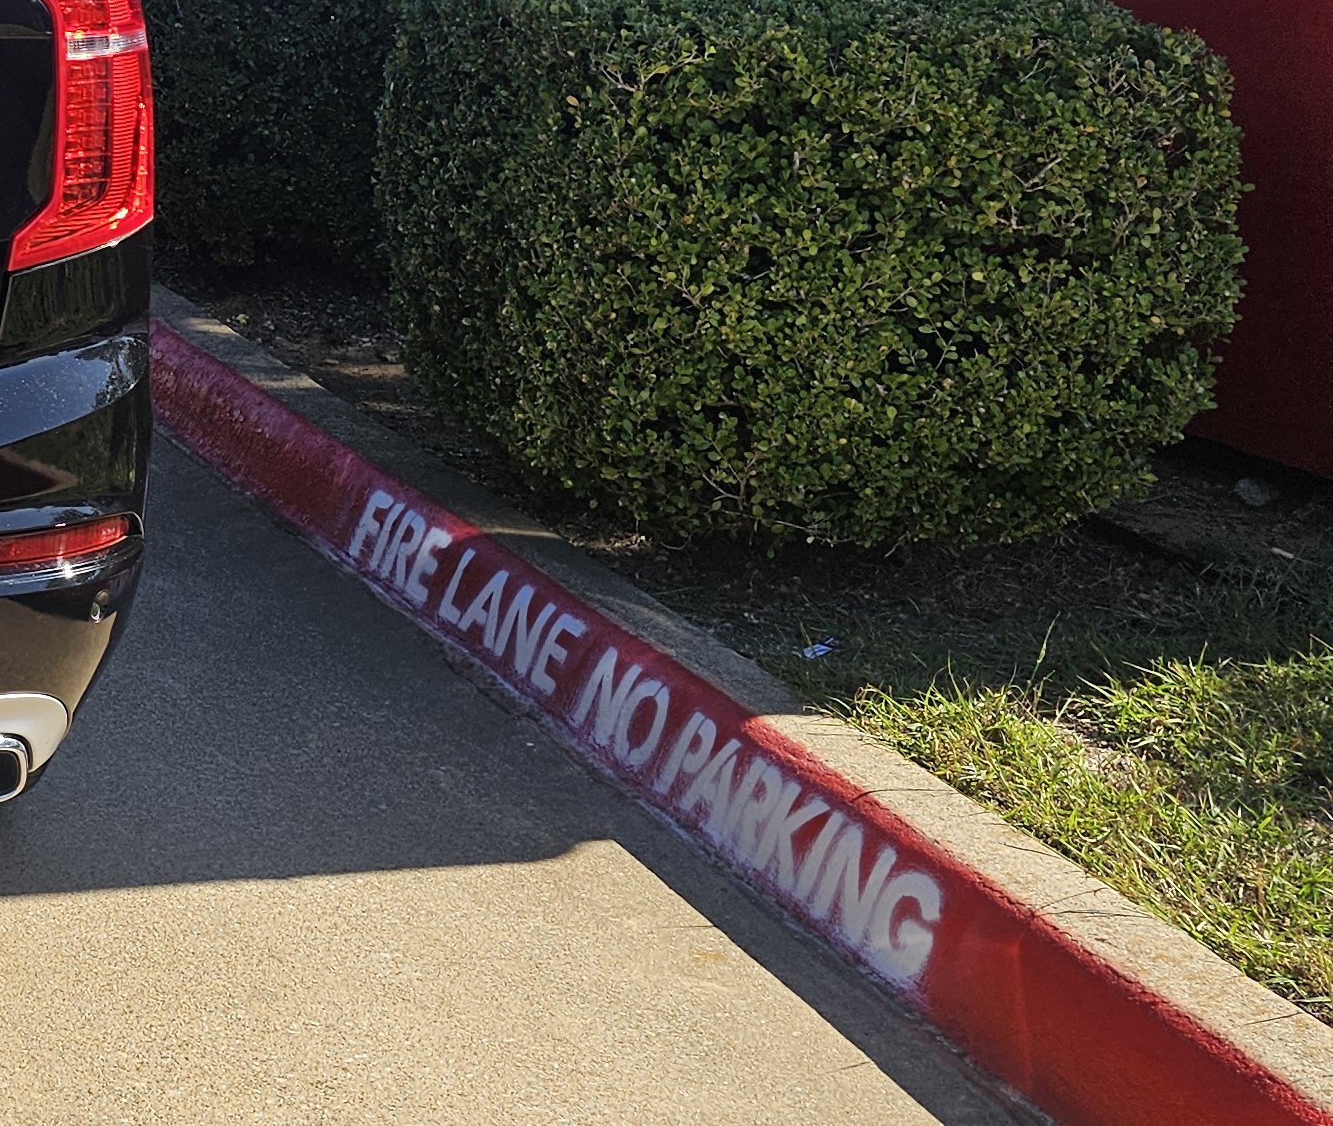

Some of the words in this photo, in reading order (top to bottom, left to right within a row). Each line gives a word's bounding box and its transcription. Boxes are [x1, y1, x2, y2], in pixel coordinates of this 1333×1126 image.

[347, 489, 454, 606] FIRE
[438, 547, 589, 695] LANE
[571, 646, 670, 774] NO
[651, 710, 943, 982] PARKING
